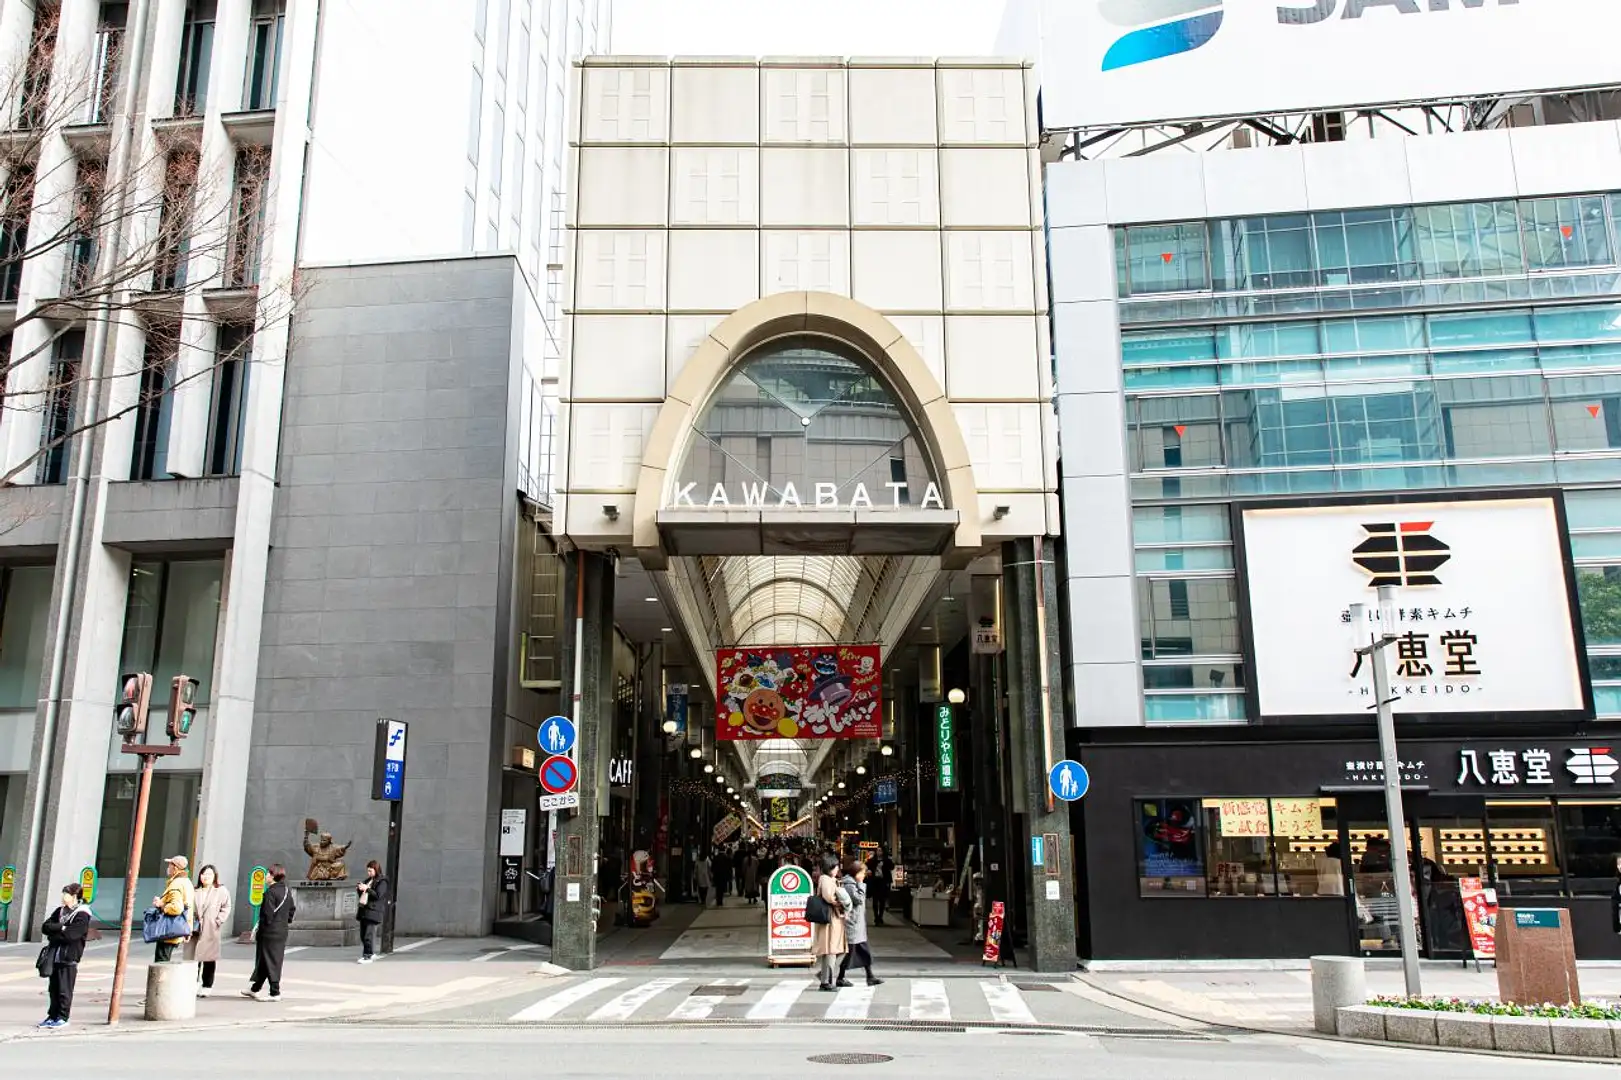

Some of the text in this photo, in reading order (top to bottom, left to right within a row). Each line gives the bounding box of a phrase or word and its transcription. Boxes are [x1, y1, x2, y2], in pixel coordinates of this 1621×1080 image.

[673, 481, 945, 509] KAWABATA
[939, 706, 952, 787] みどりや仏壇店
[1457, 748, 1554, 785] 八恵堂
[542, 796, 576, 808] ここから
[1275, 802, 1317, 815] キムチ
[1279, 820, 1316, 833] どうぞ
